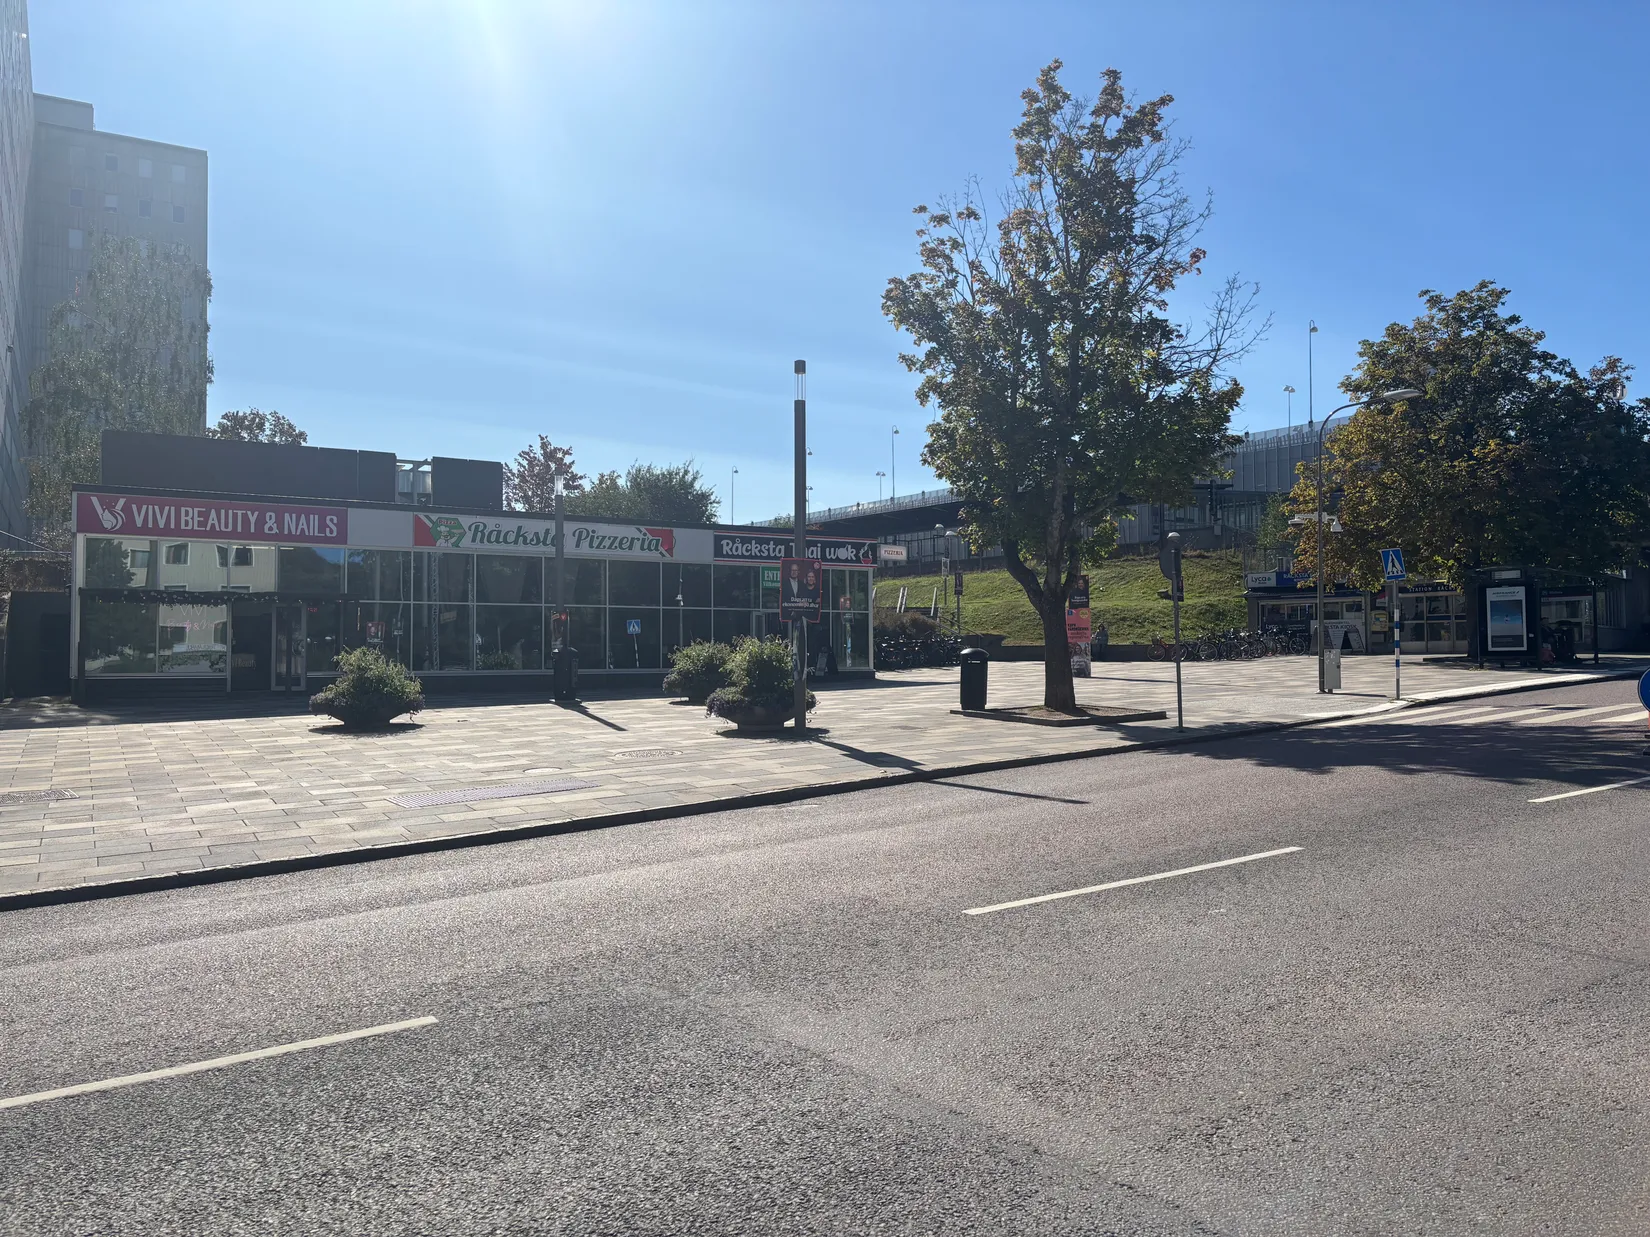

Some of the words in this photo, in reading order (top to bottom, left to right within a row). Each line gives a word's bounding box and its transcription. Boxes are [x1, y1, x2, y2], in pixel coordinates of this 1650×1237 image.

[131, 503, 175, 529] VIVI
[180, 506, 259, 533] BEAUTY
[264, 511, 279, 534] &
[284, 513, 338, 537] NAILS
[572, 527, 662, 552] Pizzeria
[720, 538, 785, 558] Råcksta
[789, 542, 821, 559] Tai
[1251, 576, 1267, 584] Lyca
